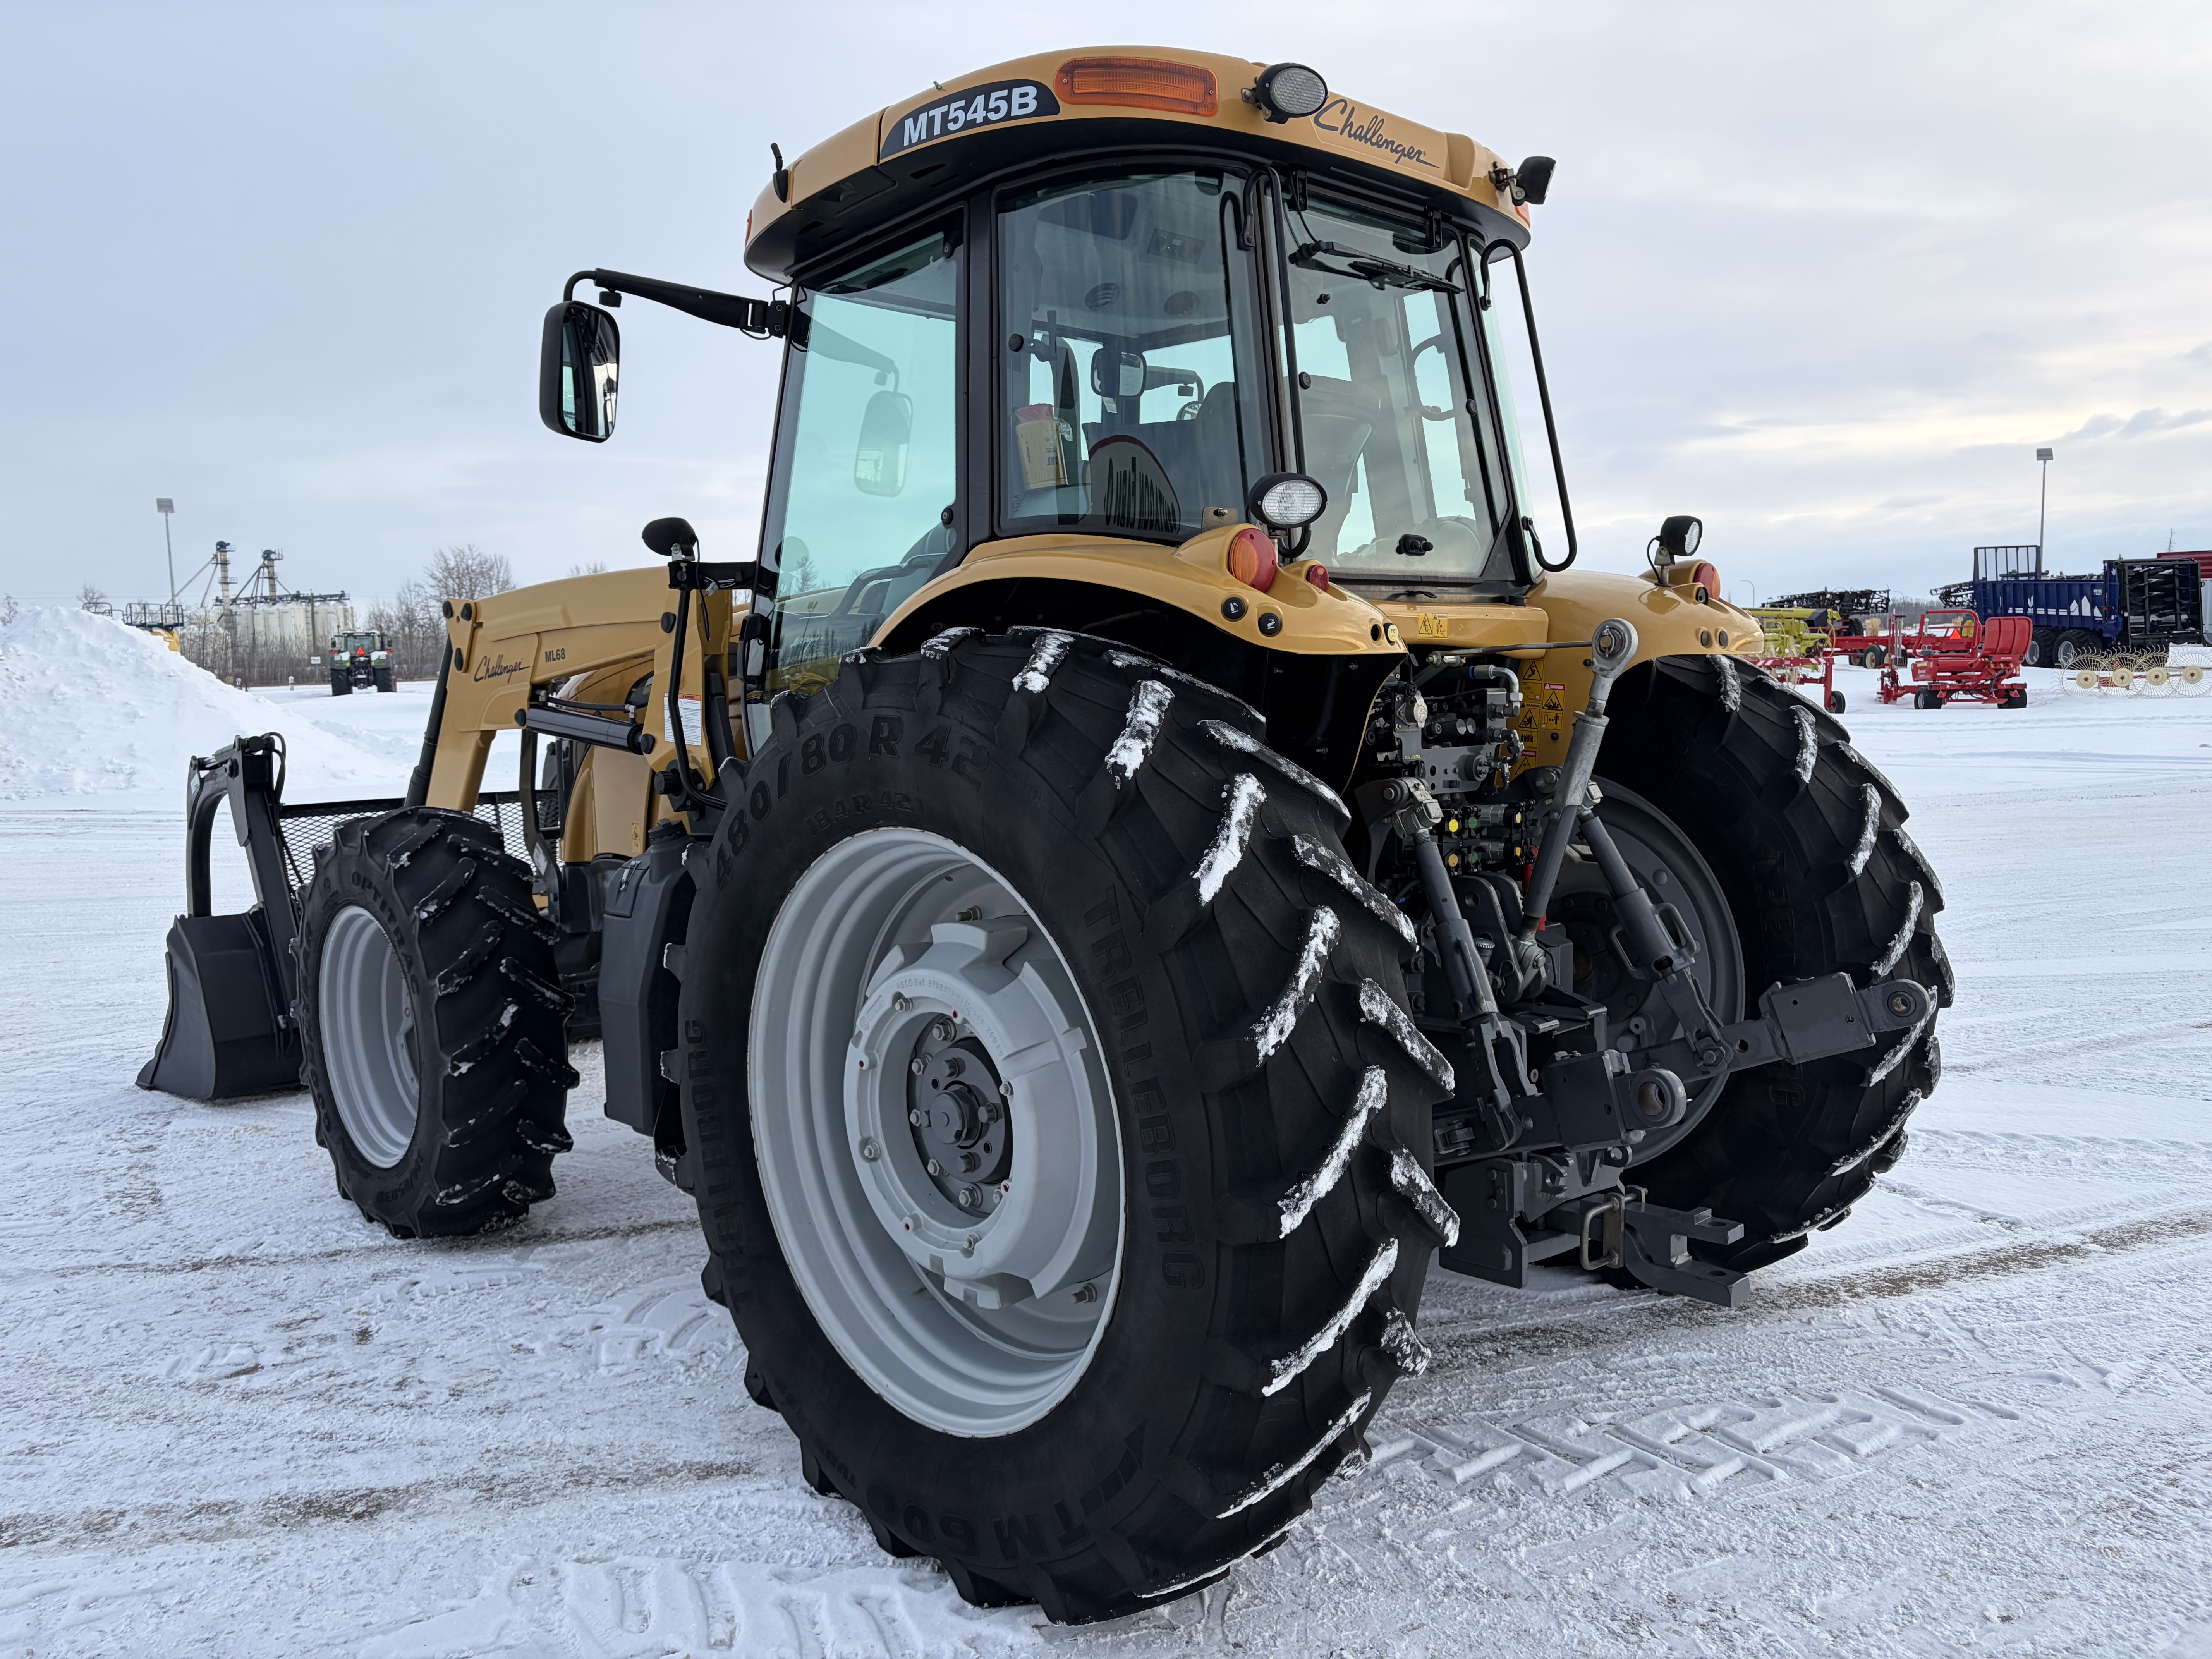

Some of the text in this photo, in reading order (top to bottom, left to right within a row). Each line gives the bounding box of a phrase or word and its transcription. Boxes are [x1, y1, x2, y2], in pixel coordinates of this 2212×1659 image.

[903, 86, 1037, 147] MT545B
[1313, 99, 1440, 168] Challenger
[474, 654, 531, 684] Challenger
[545, 648, 566, 663] ML68
[352, 872, 419, 995] OPTITRAC
[896, 979, 913, 990] AGCO
[1085, 883, 1205, 1290] TRELLEBORG
